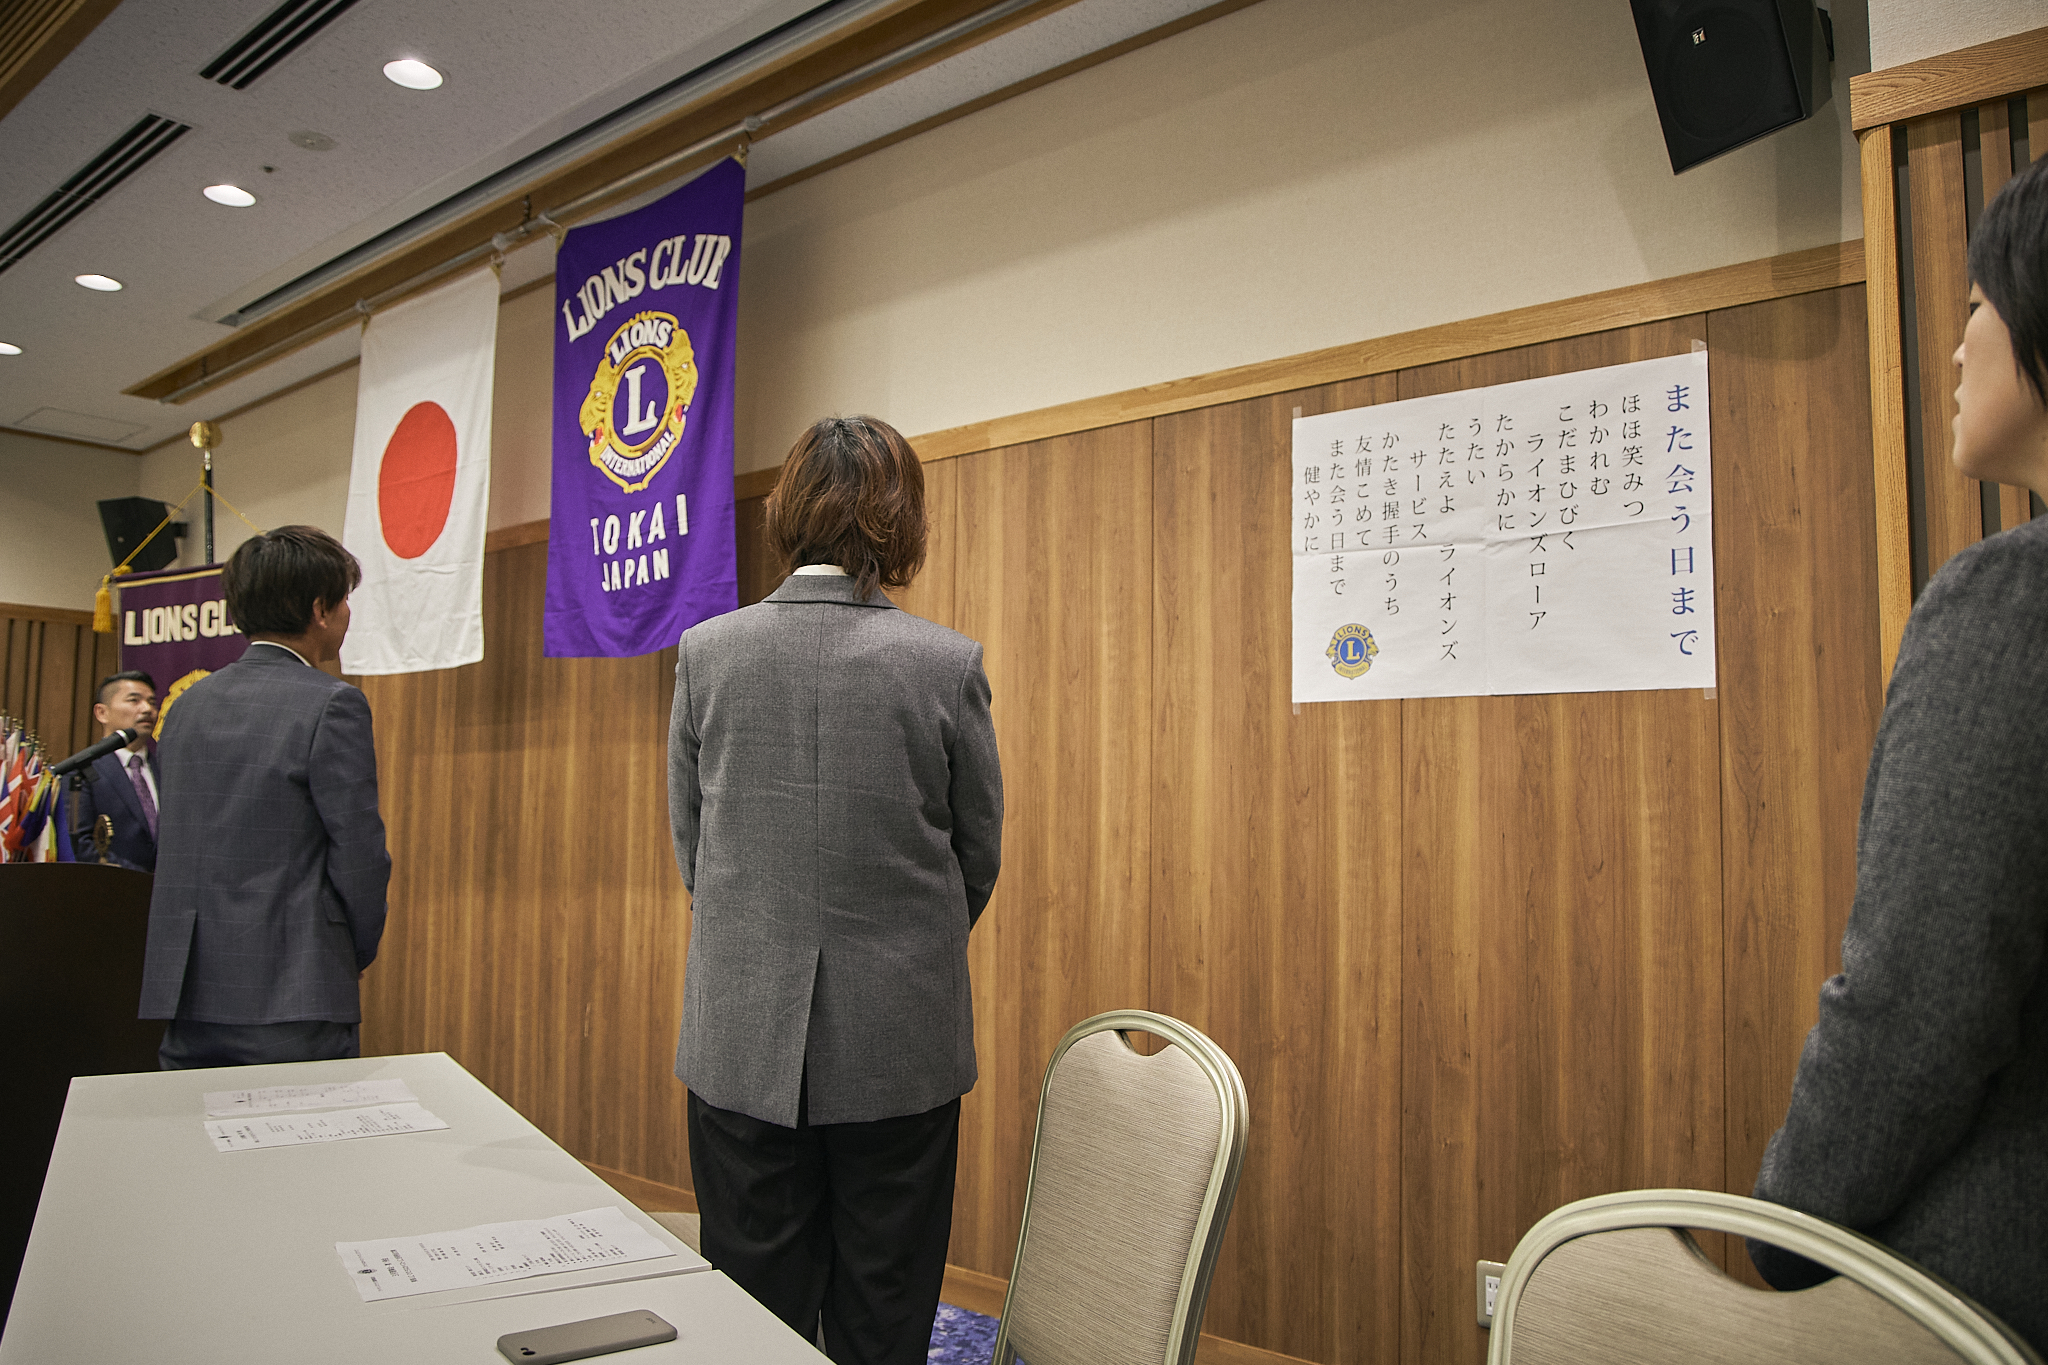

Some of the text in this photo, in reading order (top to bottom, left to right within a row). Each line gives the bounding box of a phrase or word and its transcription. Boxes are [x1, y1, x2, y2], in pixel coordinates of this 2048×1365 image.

[562, 247, 647, 344] LIONS
[609, 318, 673, 365] LIONS
[622, 364, 659, 436] L
[1588, 399, 1610, 496] わかれむ
[599, 430, 676, 478] INTERNATIONAL
[1355, 435, 1373, 546] 友情こめて
[1410, 450, 1428, 541] サービス
[1467, 418, 1486, 485] うたい
[1496, 413, 1516, 531] たからかに
[1558, 405, 1579, 550] こだまひびく
[1621, 394, 1645, 517] ほほ笑みつ
[1304, 465, 1321, 552] 健やかに
[1330, 439, 1347, 596] また会う日まで
[1382, 431, 1400, 616] かたき握手のうち
[1438, 423, 1459, 661] たたえよ ライオンズ
[1527, 433, 1548, 630] ライオンズローア
[1665, 384, 1699, 656] また会う日まで
[601, 547, 670, 592] JAPAN
[123, 599, 243, 646] LIONS CL
[1337, 625, 1368, 639] LIONS
[1346, 640, 1361, 660] L
